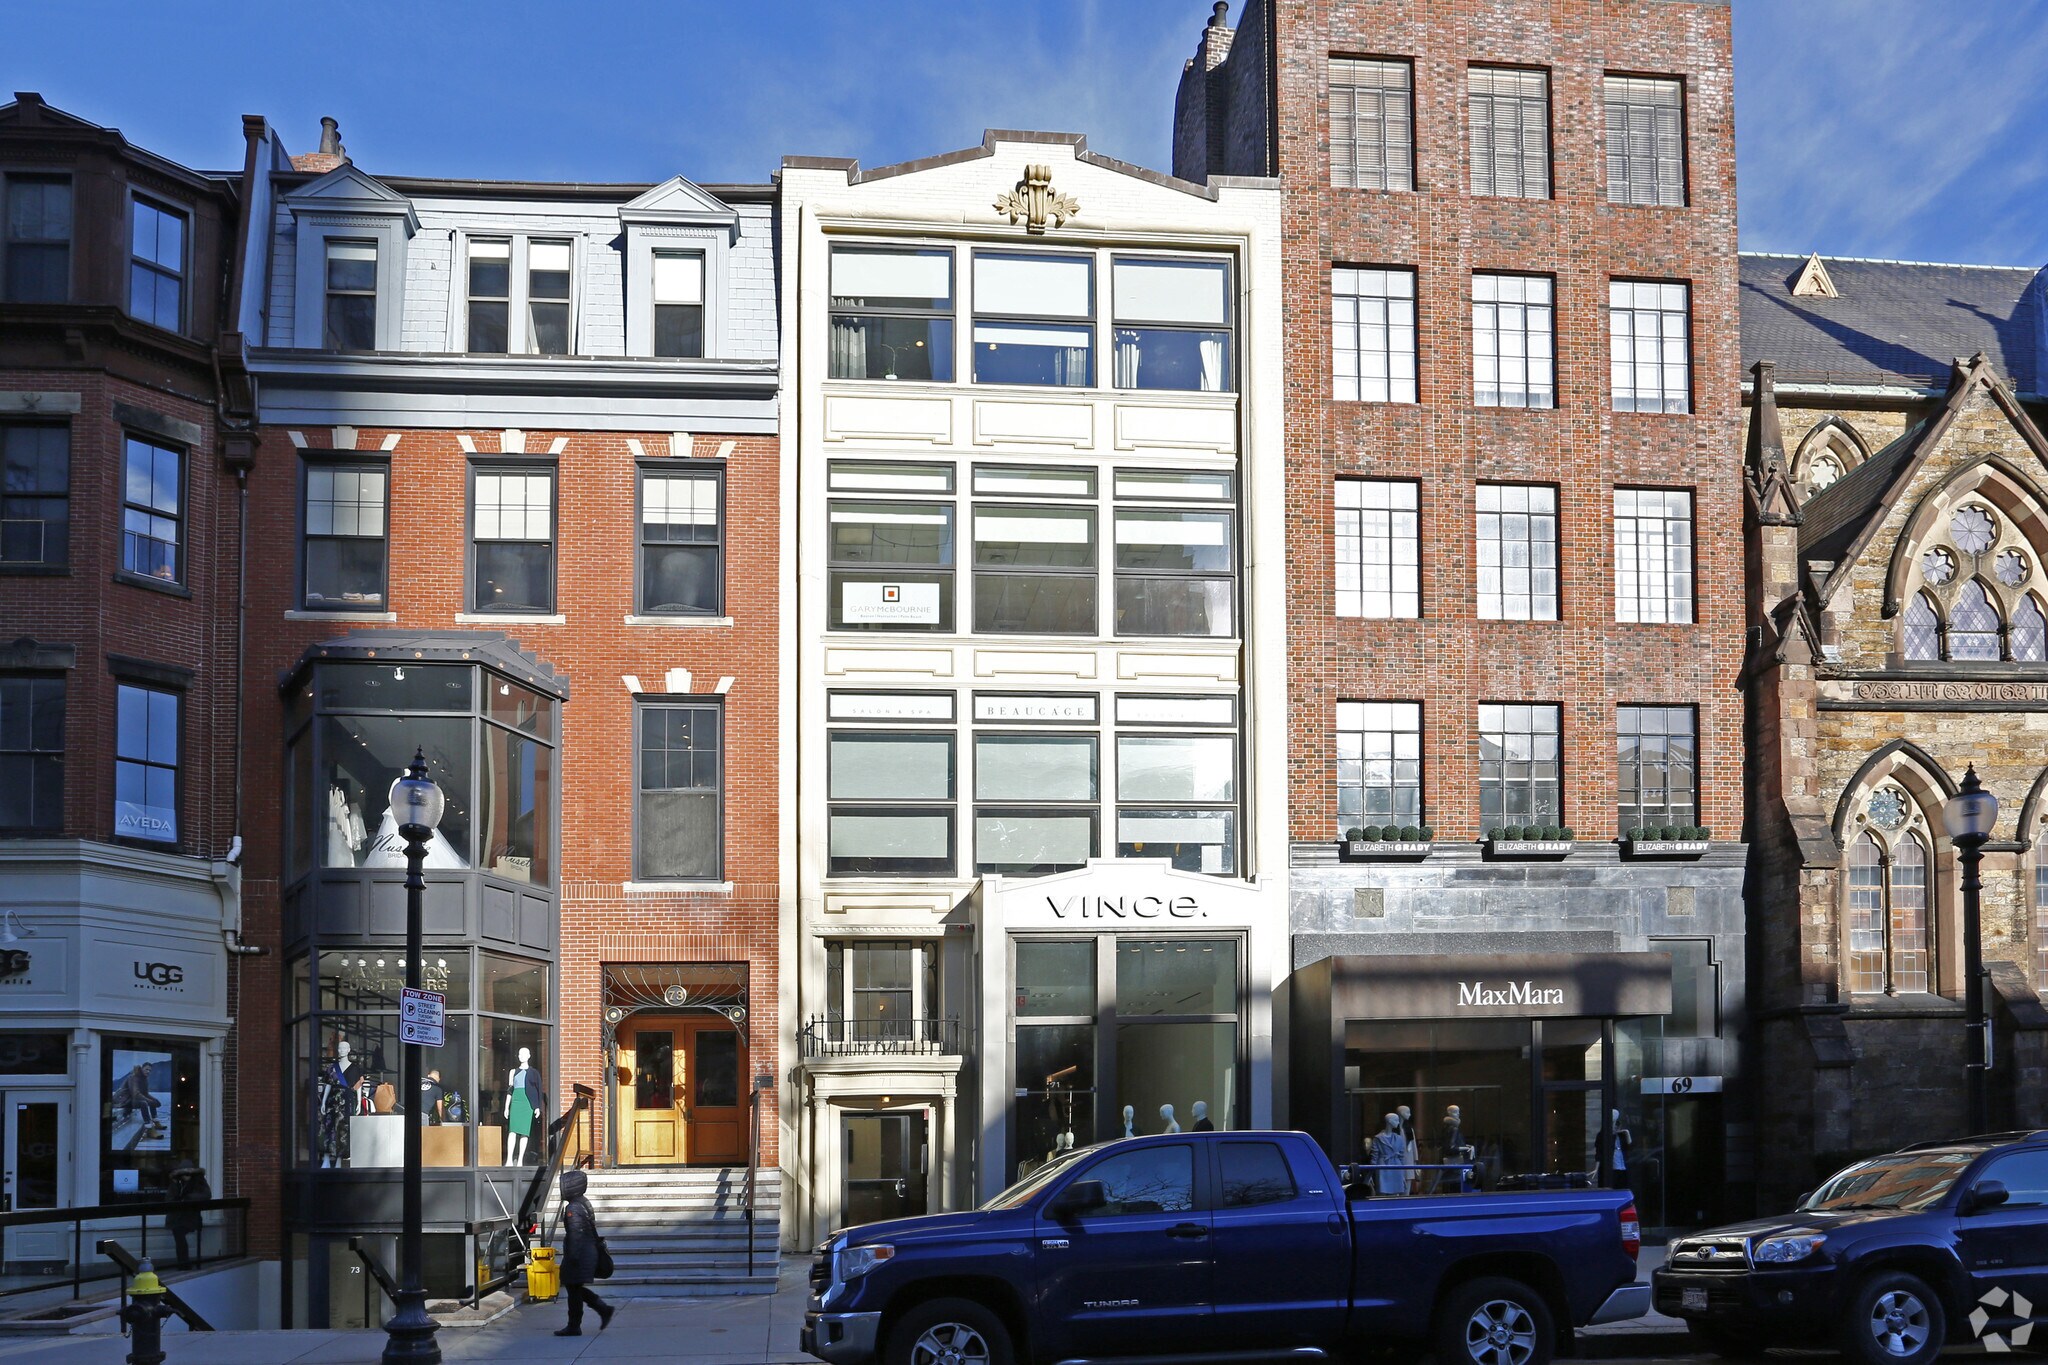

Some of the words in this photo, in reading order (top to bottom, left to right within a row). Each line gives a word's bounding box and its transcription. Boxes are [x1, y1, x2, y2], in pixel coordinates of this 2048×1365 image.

[119, 814, 172, 832] AVEDA
[1353, 843, 1394, 852] ELIZABETH
[1394, 843, 1431, 852] GRADY
[1497, 842, 1537, 851] ELIZABETH
[1537, 842, 1572, 851] GRADY
[1637, 843, 1675, 851] ELIZABETH
[1675, 842, 1709, 851] GRADY
[133, 961, 184, 986] UGG
[133, 984, 184, 993] australia
[1456, 980, 1565, 1006] MaxMara
[405, 990, 421, 999] TOW
[422, 993, 443, 1002] ZONE
[667, 991, 684, 1001] 73
[417, 1002, 436, 1010] STREET
[417, 1008, 441, 1017] CLEANING
[879, 1077, 892, 1087] 71
[1671, 1077, 1693, 1094] 69
[350, 1266, 361, 1274] 73
[1083, 1299, 1140, 1308] TUNDRA
